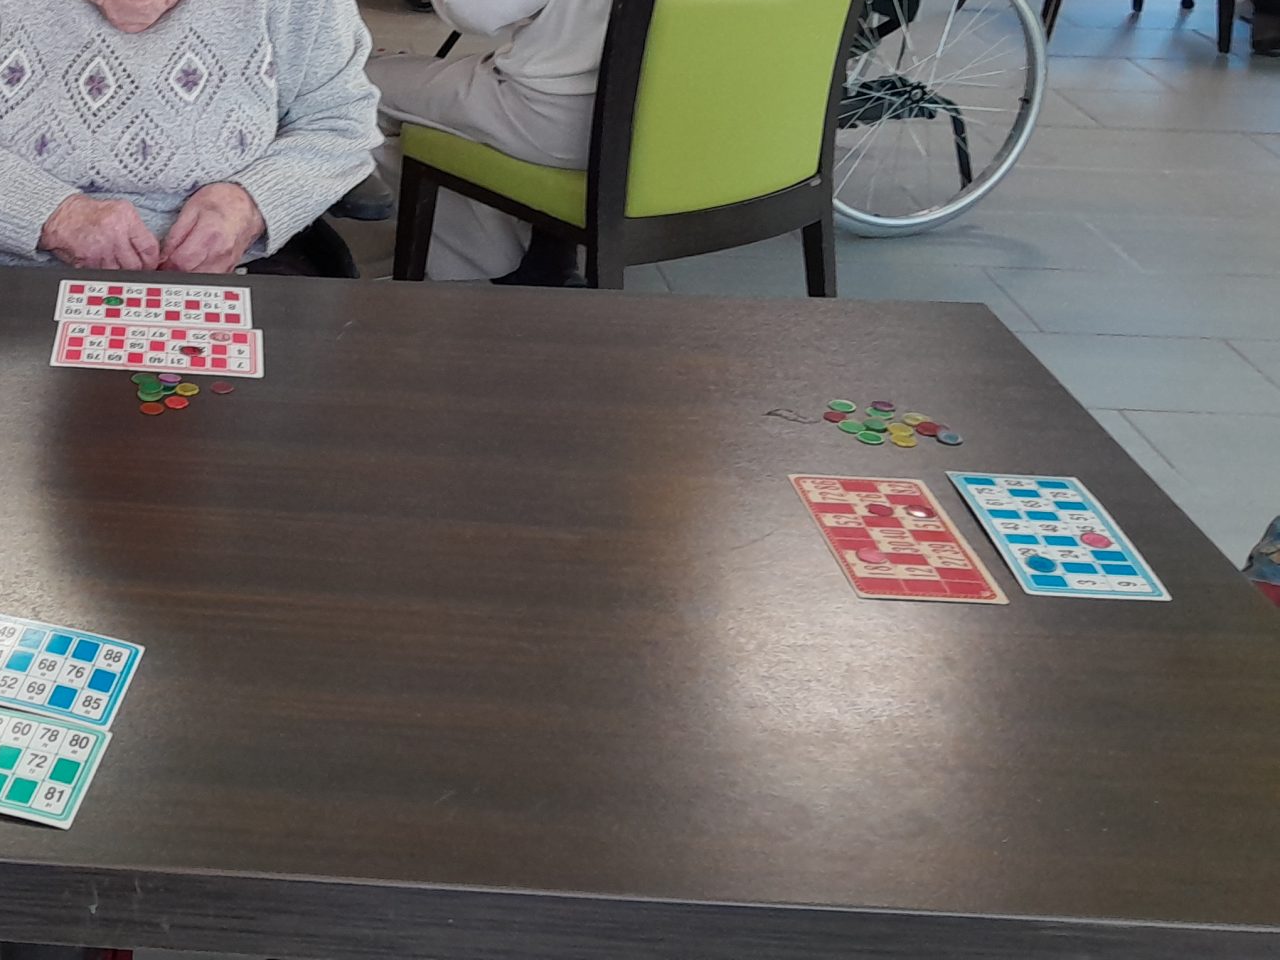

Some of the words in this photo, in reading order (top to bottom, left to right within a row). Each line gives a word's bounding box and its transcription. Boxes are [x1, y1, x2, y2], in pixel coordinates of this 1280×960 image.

[811, 481, 840, 490] 86
[888, 484, 916, 494] 82
[819, 492, 848, 502] 72
[856, 494, 886, 503] 76
[832, 515, 862, 526] 52
[912, 518, 940, 529] 51
[880, 530, 908, 539] 40
[888, 542, 919, 552] 30
[928, 544, 960, 554] 39
[1058, 550, 1079, 558] 24
[937, 556, 968, 567] 27
[864, 566, 894, 576] 18
[905, 568, 936, 577] 12
[104, 650, 122, 662] 88
[38, 659, 57, 672] 68
[68, 665, 85, 678] 76
[0, 676, 18, 689] 52
[27, 682, 46, 695] 69
[82, 696, 102, 710] 85
[12, 722, 32, 736] 60
[40, 728, 59, 742] 78
[69, 734, 89, 749] 80
[28, 753, 47, 768] 72
[44, 787, 64, 802] 81
